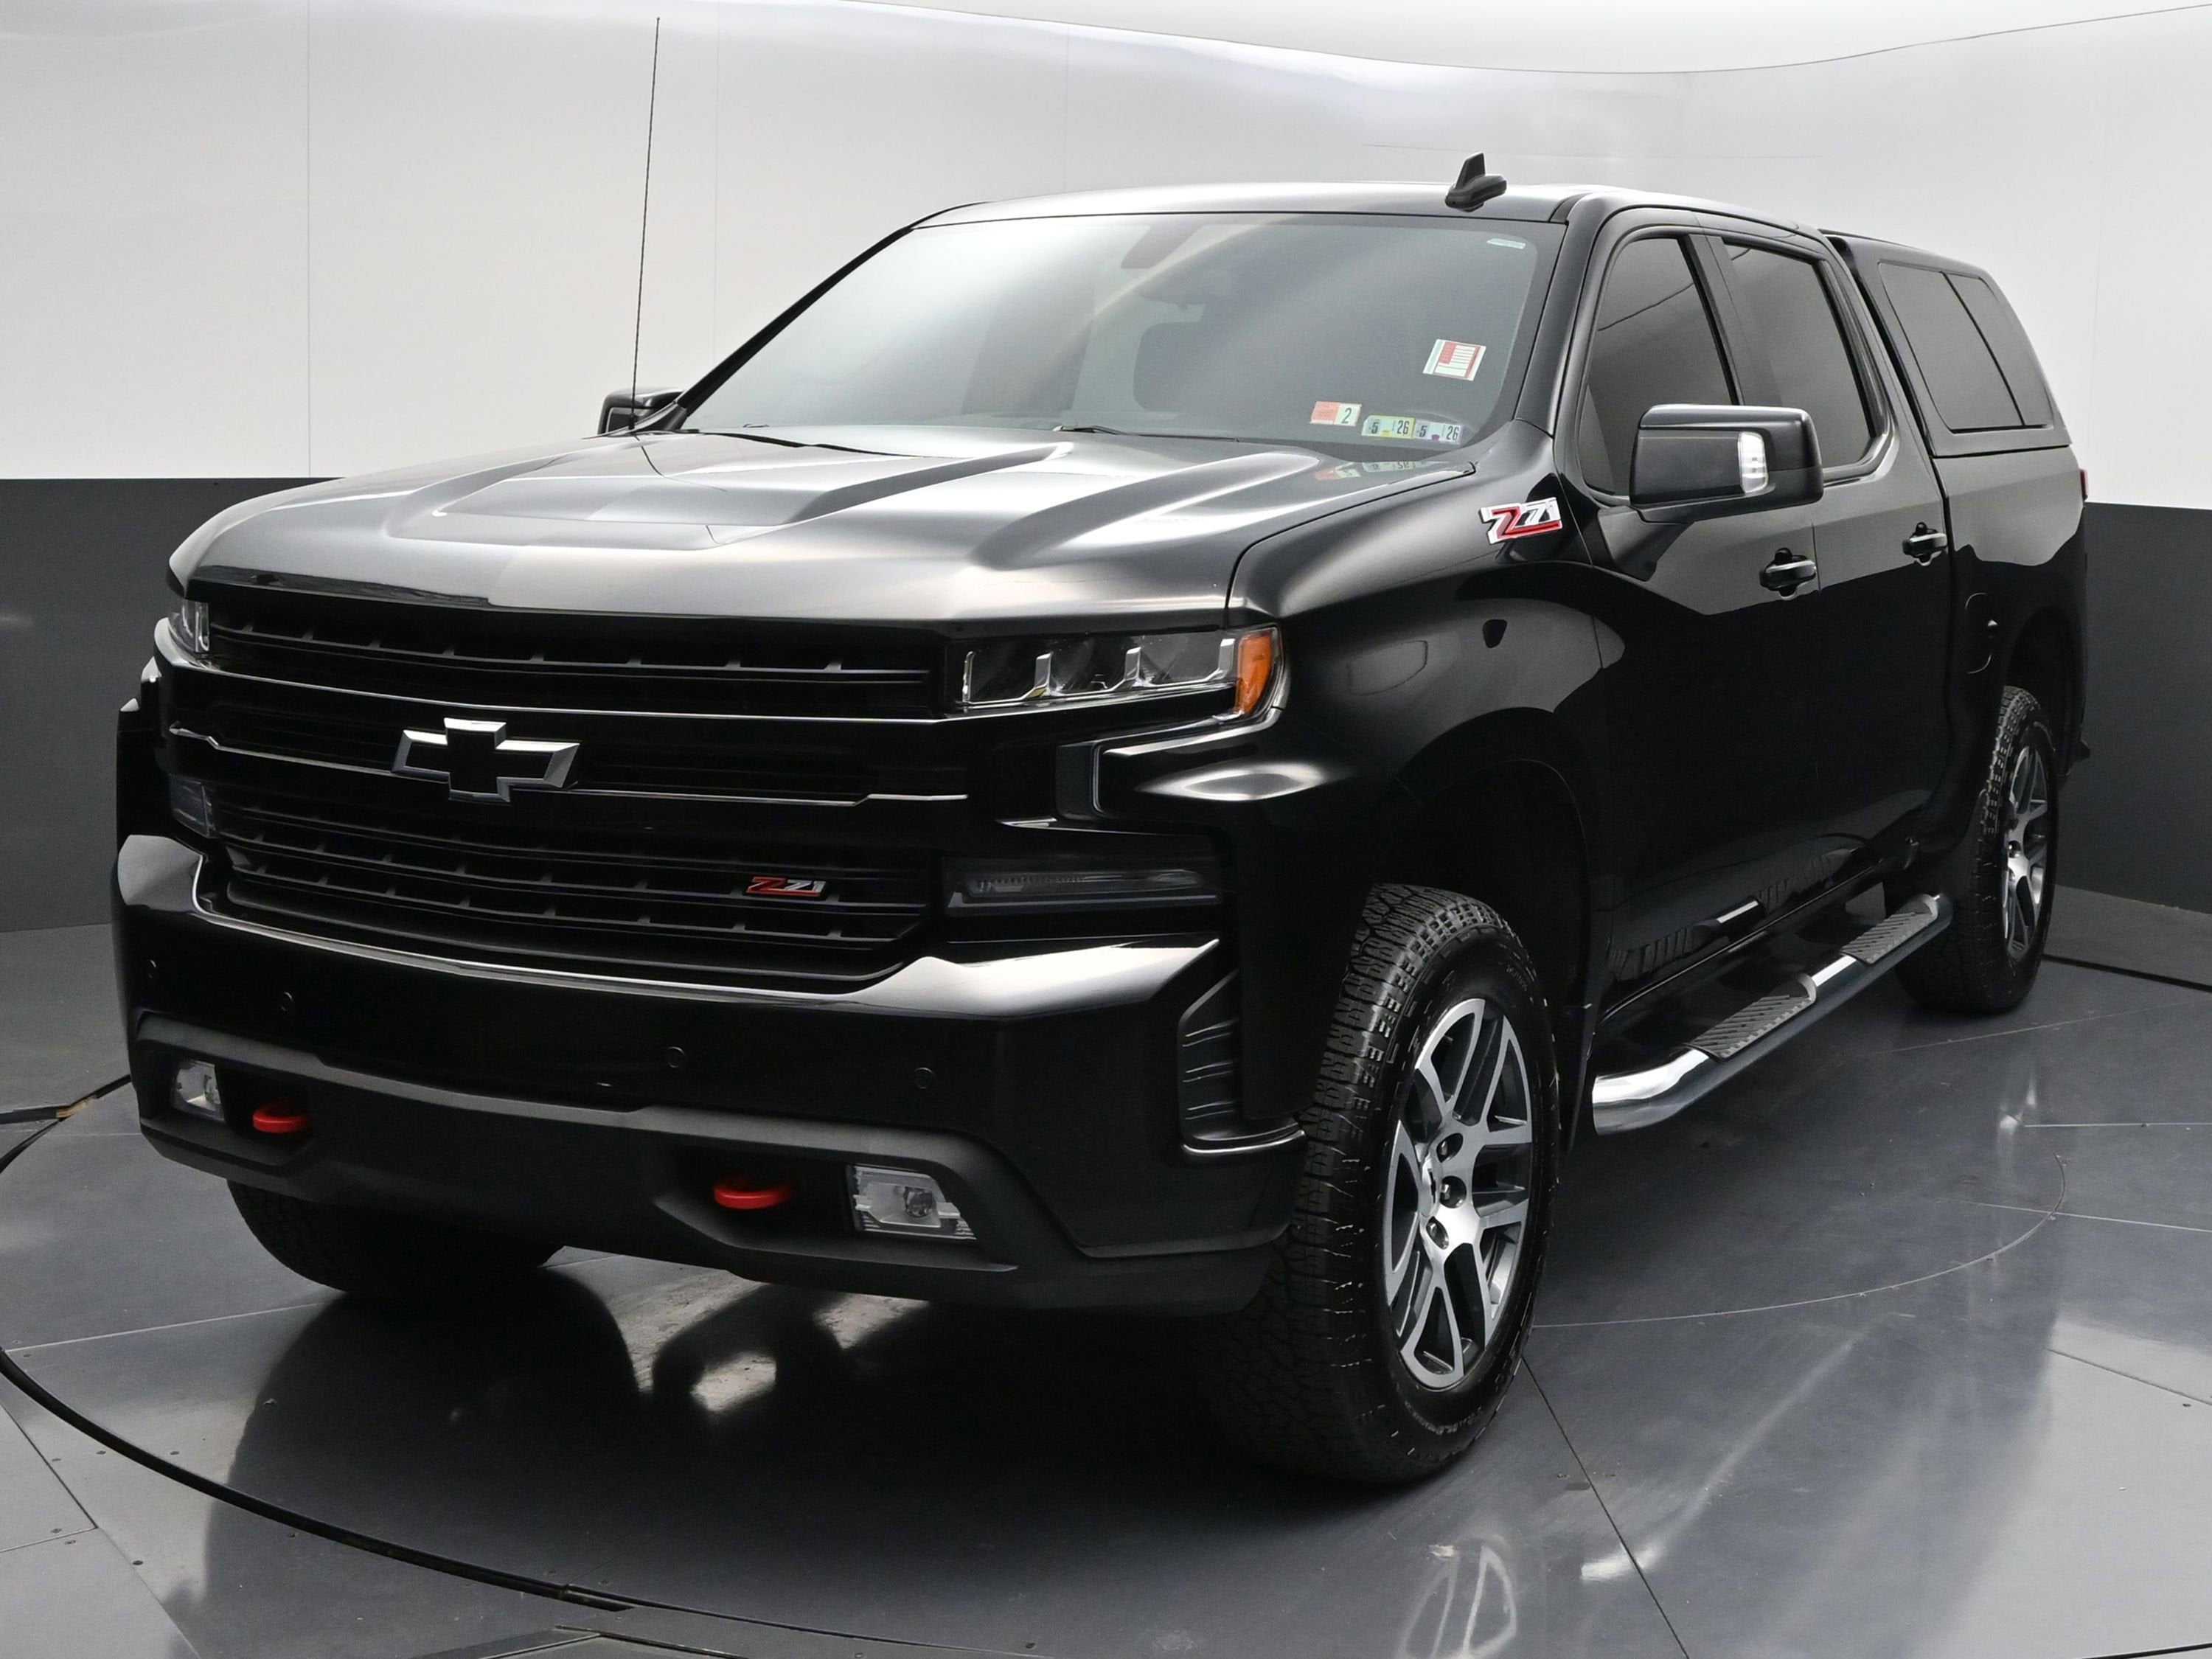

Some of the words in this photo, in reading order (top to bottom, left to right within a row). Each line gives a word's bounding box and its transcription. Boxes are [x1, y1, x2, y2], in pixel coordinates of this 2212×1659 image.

[1340, 407, 1352, 424] 2
[1371, 421, 1380, 434] 5
[1397, 420, 1410, 435] 26
[1419, 425, 1427, 438] 5
[1446, 425, 1460, 441] 26
[1478, 497, 1562, 544] Z71
[745, 876, 826, 897] Z71
